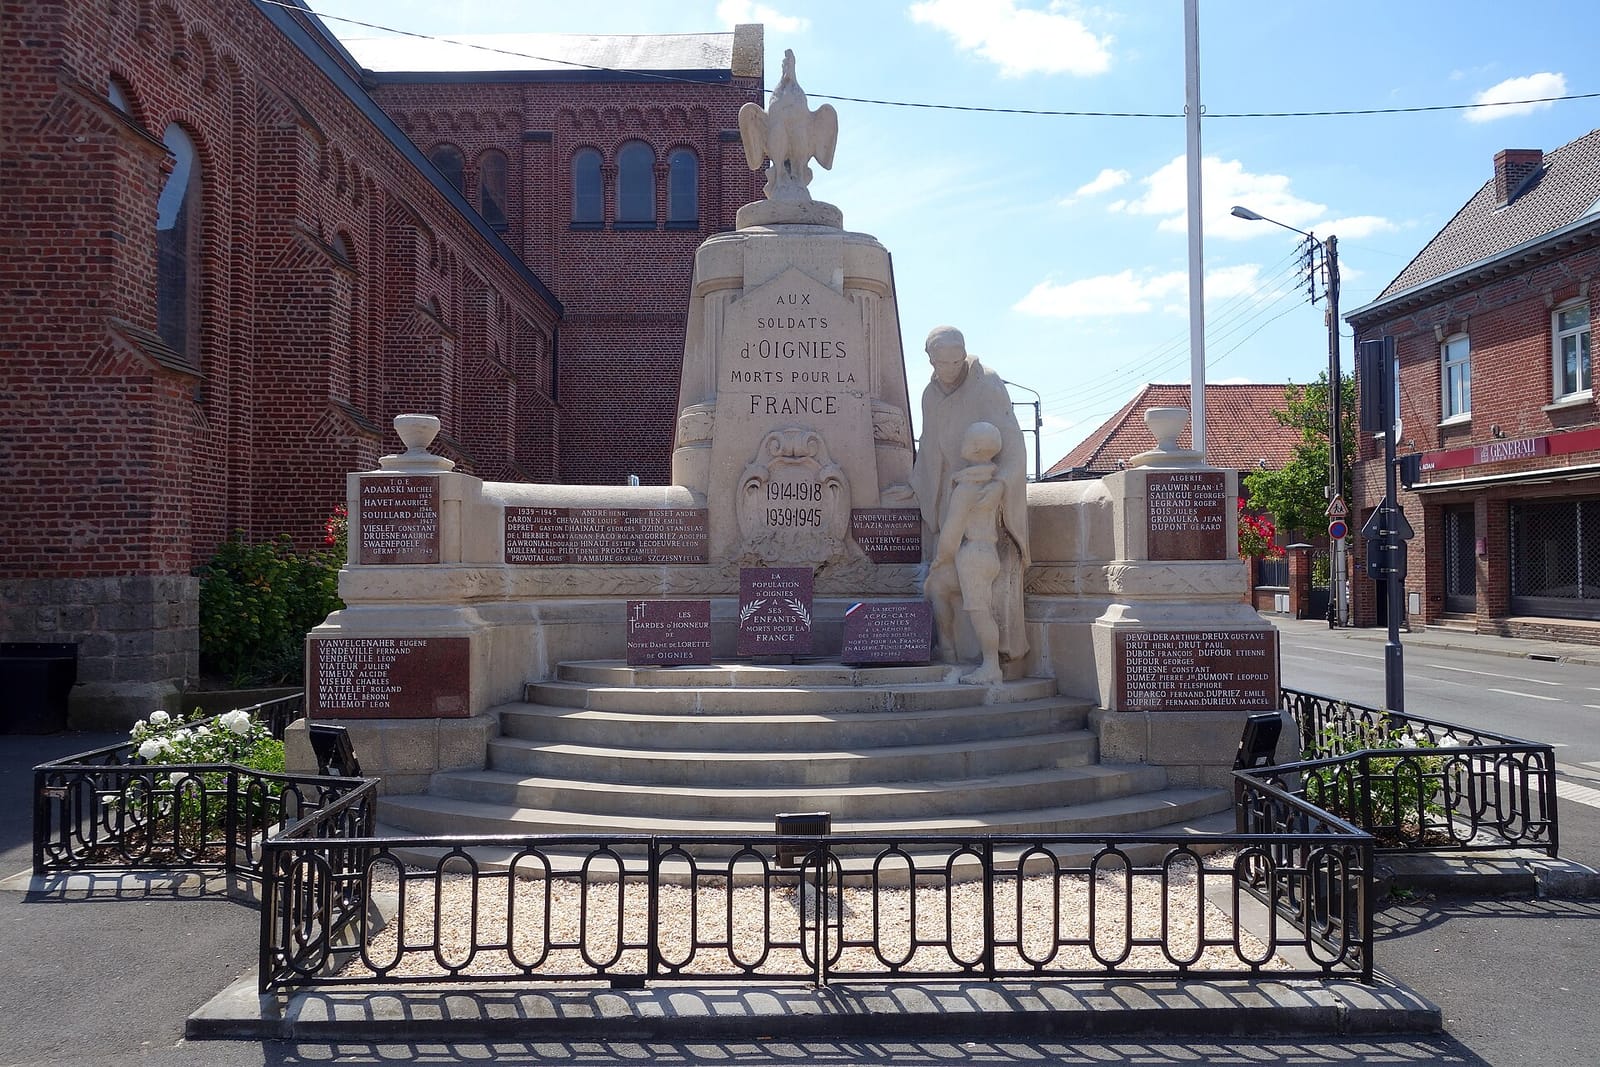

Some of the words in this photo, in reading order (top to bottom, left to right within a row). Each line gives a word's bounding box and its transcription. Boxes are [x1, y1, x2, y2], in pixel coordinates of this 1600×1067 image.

[776, 294, 810, 304] AUX
[758, 318, 828, 329] SOLDATS
[740, 340, 847, 359] d'OIGNIES
[731, 370, 784, 383] MORTS
[791, 372, 829, 383] POUR
[837, 372, 855, 383] LA
[750, 395, 837, 414] FRANCE
[1490, 438, 1536, 457] GENERALI
